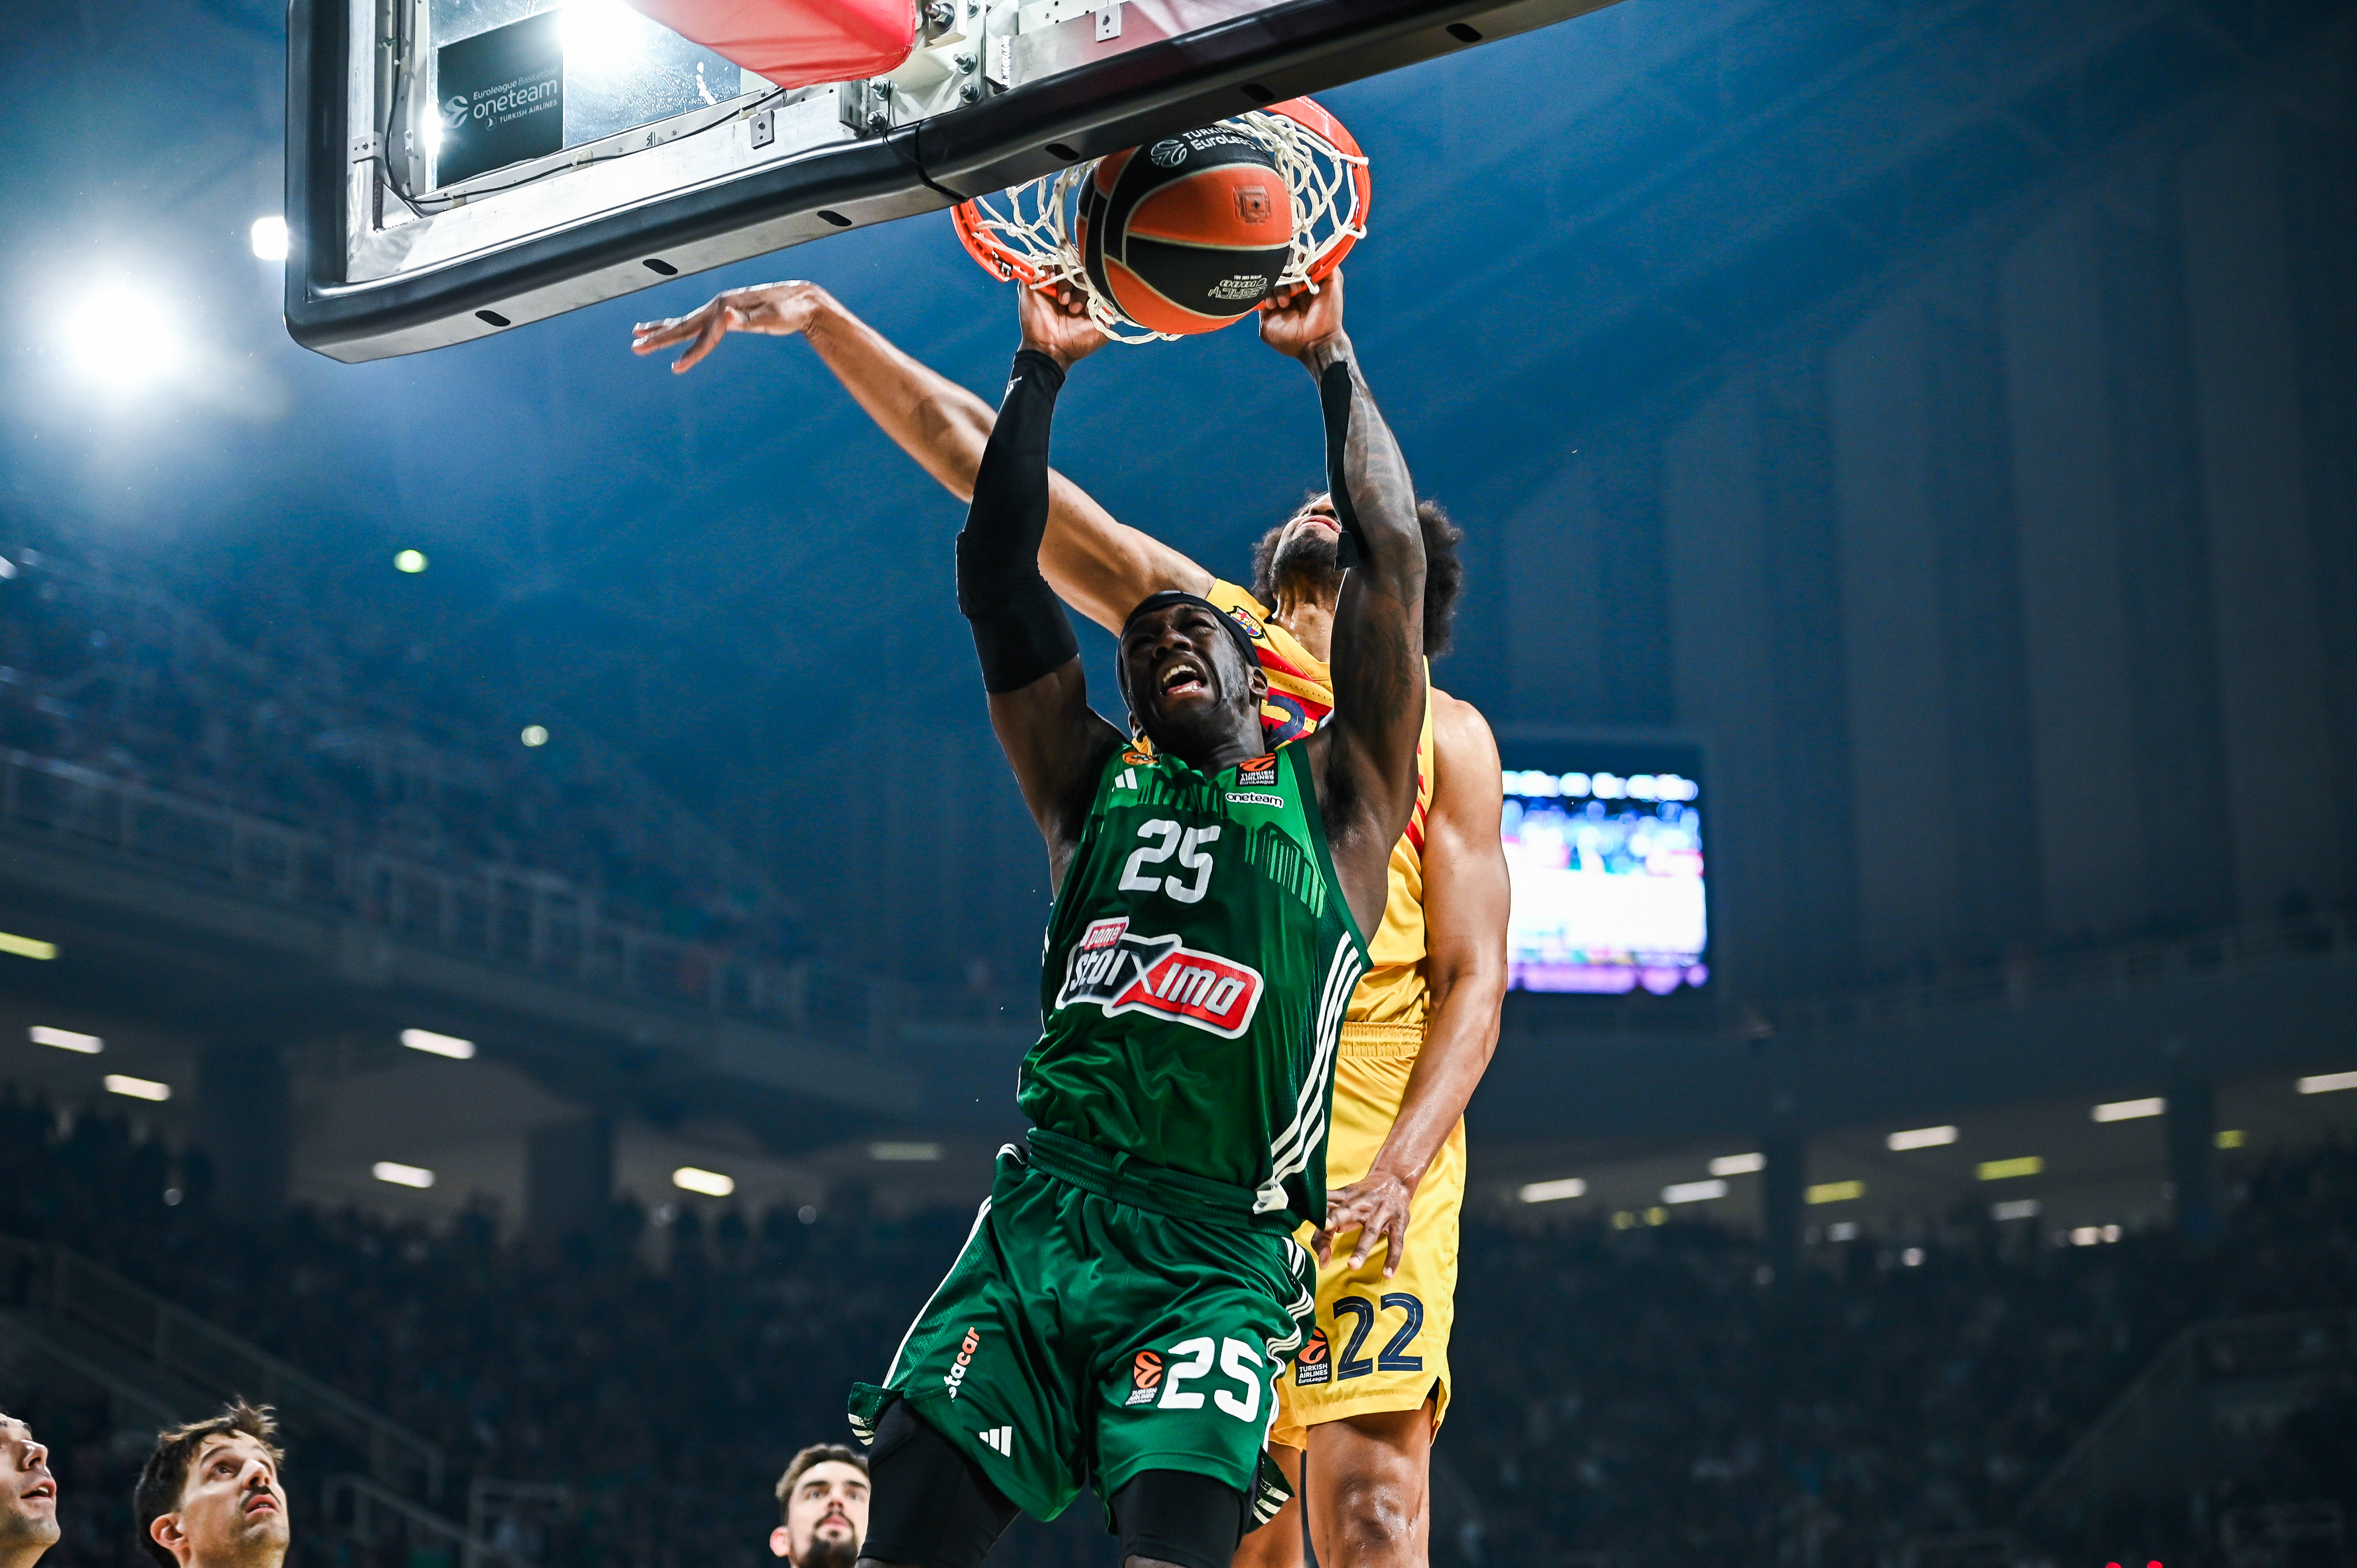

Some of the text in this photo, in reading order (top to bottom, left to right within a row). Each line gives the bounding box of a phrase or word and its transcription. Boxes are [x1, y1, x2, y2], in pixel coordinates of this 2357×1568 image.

[473, 66, 557, 101] Euroleague Basketball
[473, 79, 558, 119] oneteam
[499, 99, 558, 123] TURKISH AIRLINES
[1227, 793, 1283, 806] oneteam
[1118, 819, 1221, 903] 25
[1087, 926, 1122, 949] pame
[1333, 1292, 1424, 1381] 22
[1157, 1336, 1263, 1423] 25
[1298, 1376, 1328, 1384] EuroLeague
[1299, 1363, 1328, 1373] TURKISH
[1299, 1369, 1328, 1379] AIRLINES
